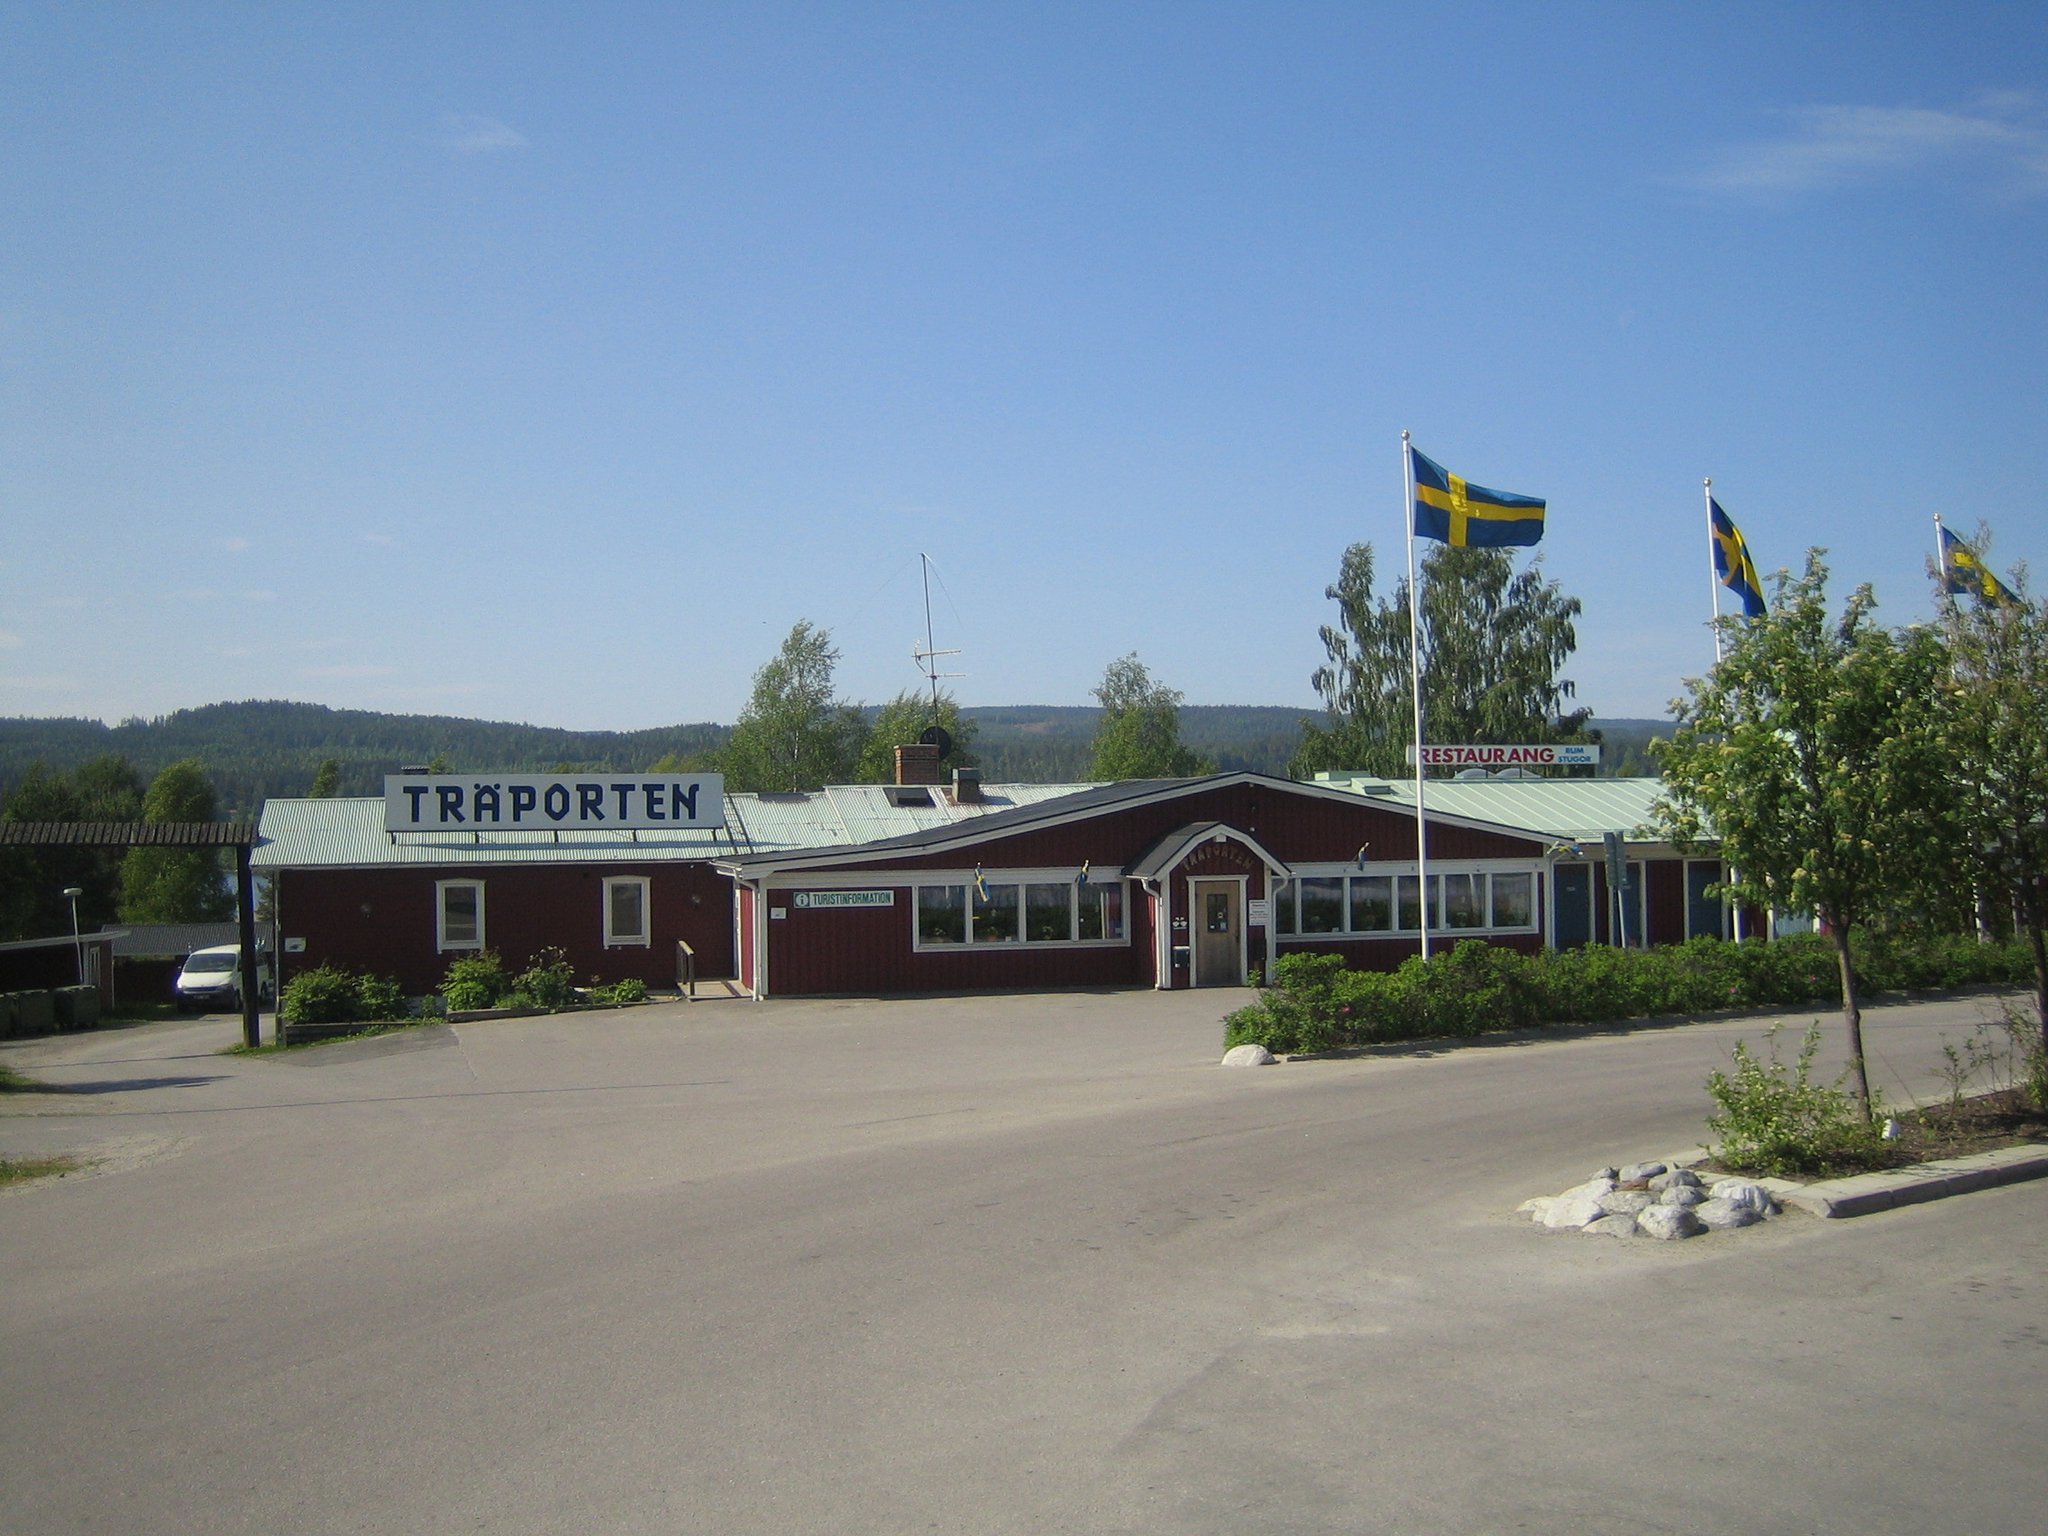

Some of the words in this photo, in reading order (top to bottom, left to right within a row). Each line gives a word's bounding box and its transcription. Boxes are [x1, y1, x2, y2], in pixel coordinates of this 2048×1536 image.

[1421, 748, 1554, 763] RESTAURANG
[402, 783, 699, 823] TRÄPORTEN
[813, 892, 891, 906] TURISTINFORMATION
